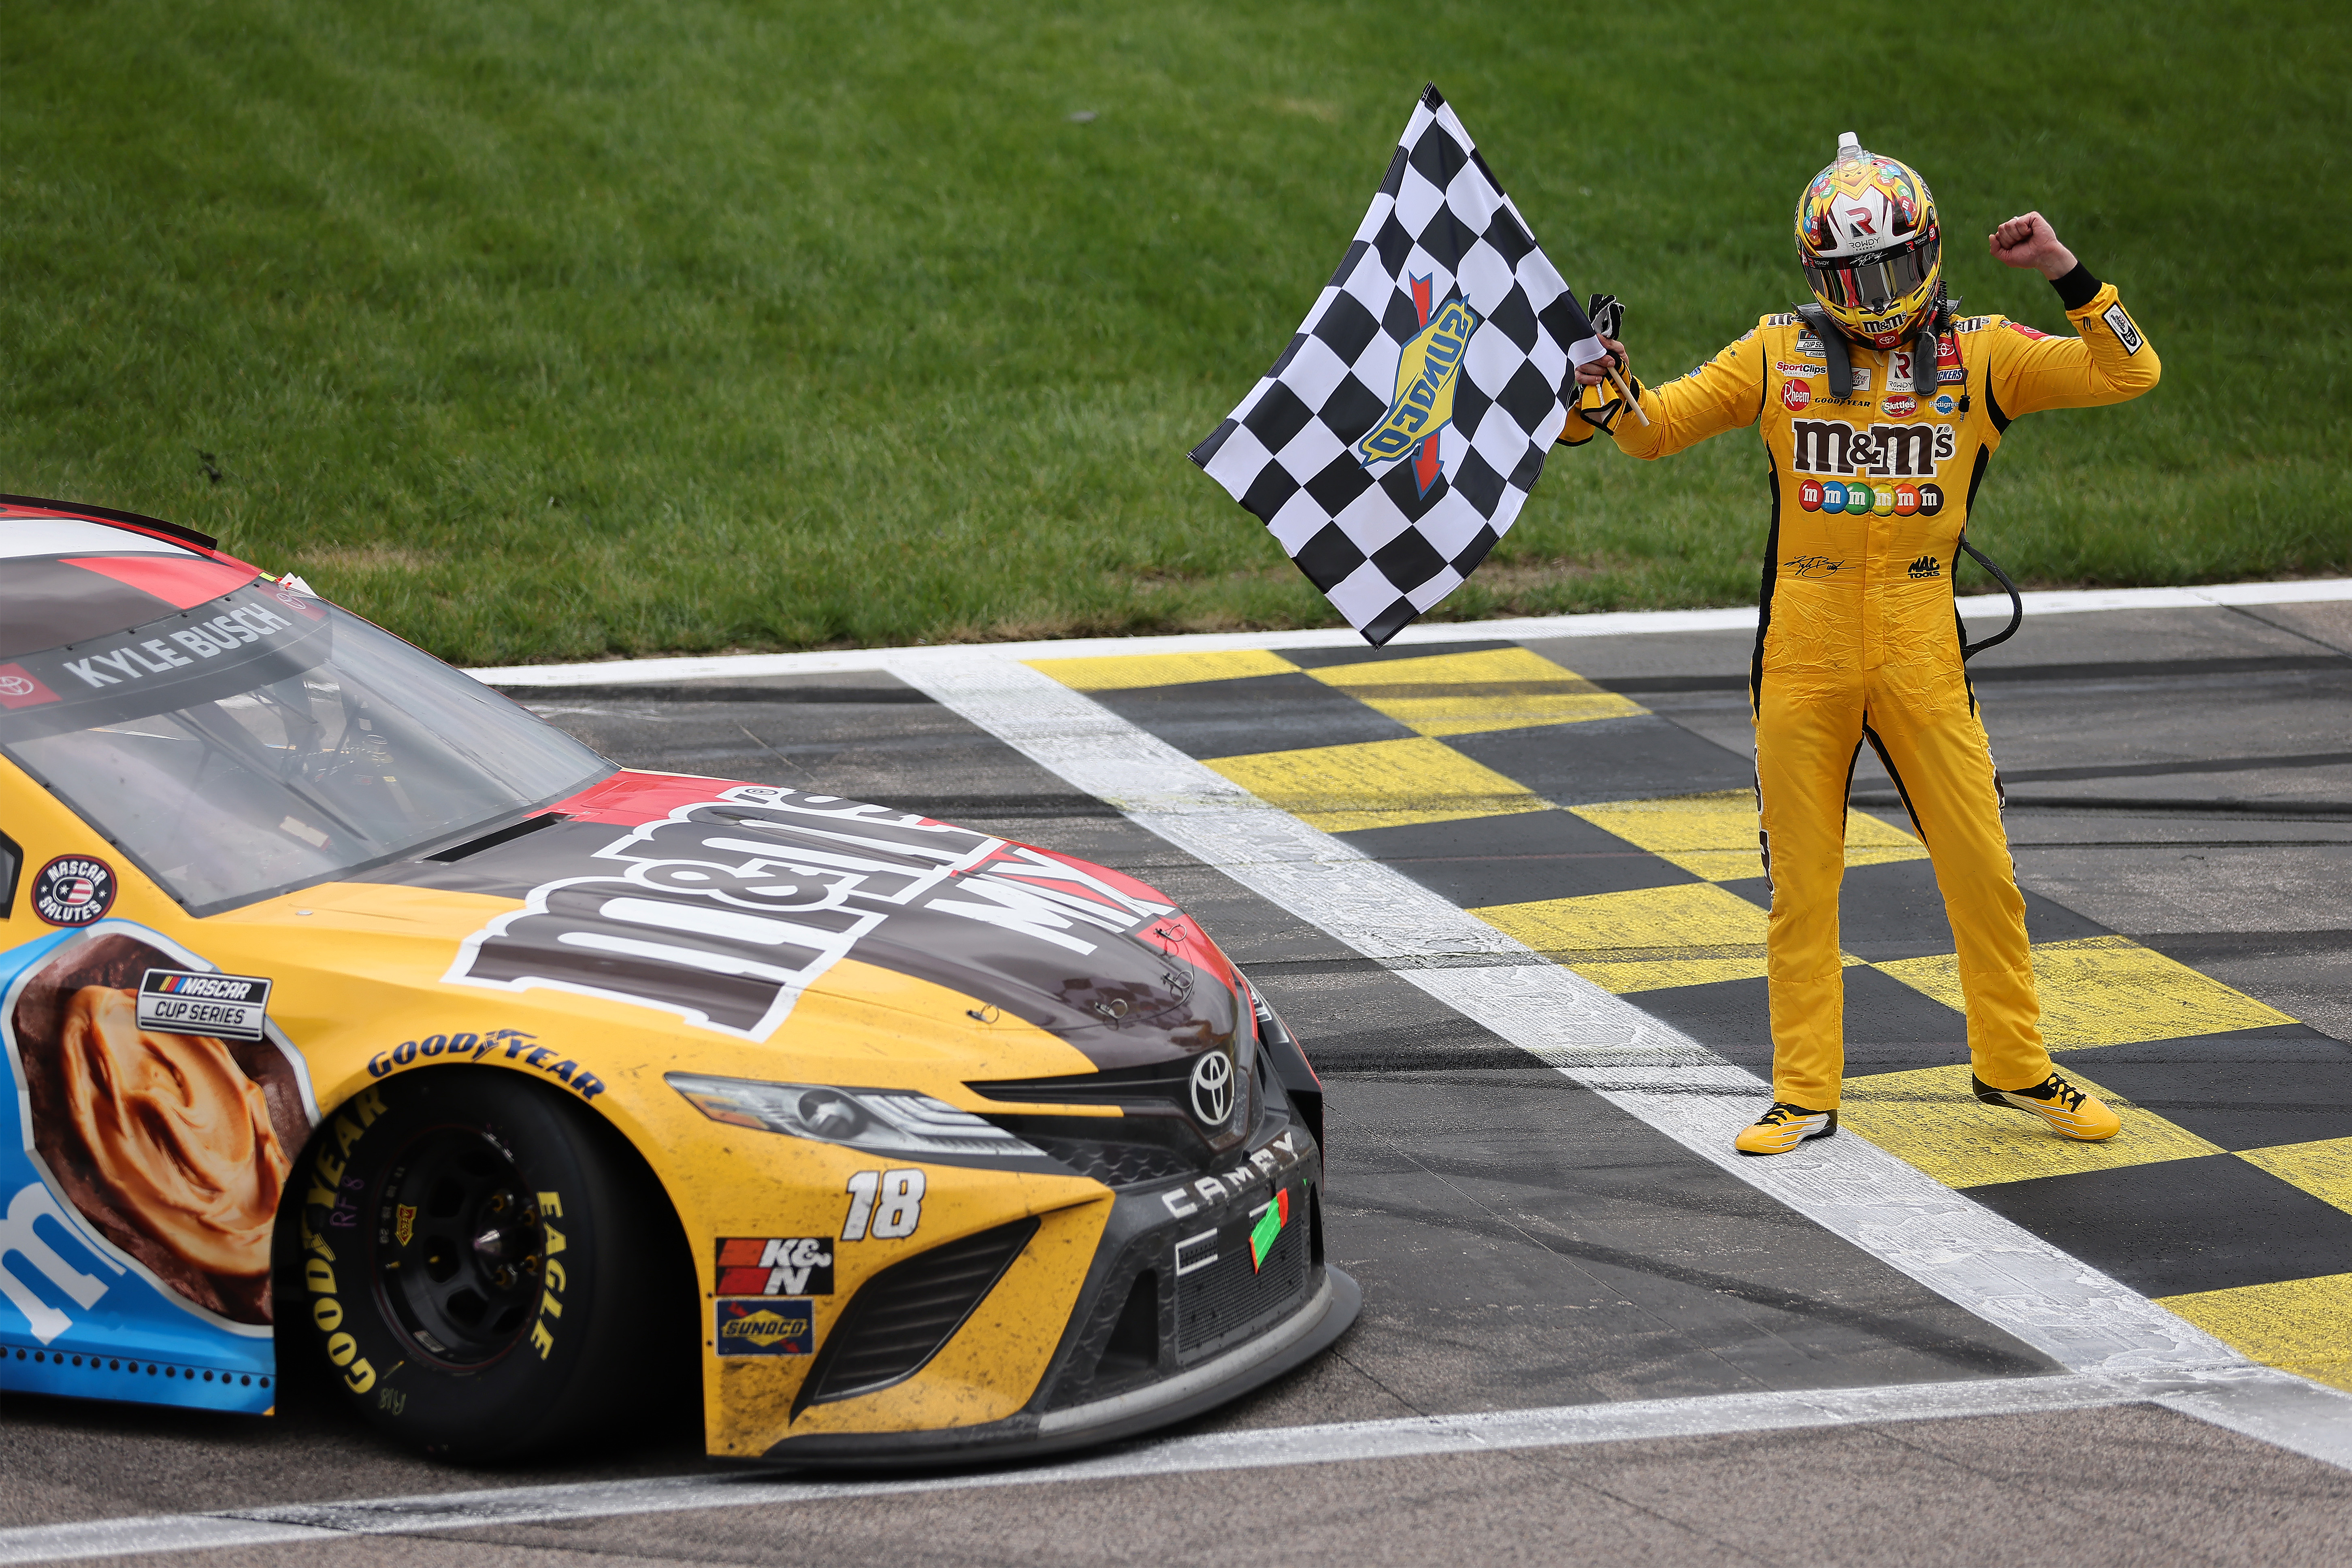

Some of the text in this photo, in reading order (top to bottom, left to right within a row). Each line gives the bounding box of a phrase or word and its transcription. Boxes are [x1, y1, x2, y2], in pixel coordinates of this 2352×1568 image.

[1849, 237, 1881, 248] ROWDY
[1914, 234, 1928, 245] ROWDY
[2125, 331, 2135, 344] sfi
[1776, 361, 1827, 374] SportClips
[1784, 379, 1810, 407] Rheem
[1815, 397, 1871, 407] GOODYEAR
[1883, 401, 1916, 411] Skittles
[1803, 488, 1937, 507] m m m m m m
[1907, 556, 1940, 573] MAC
[1908, 570, 1941, 579] TOOLS
[62, 603, 293, 688] KYLE BUSCH
[47, 859, 109, 887] NASCAR
[38, 895, 102, 922] SALUTES
[180, 977, 252, 1000] NASCAR
[155, 1001, 247, 1025] CUP SERIES
[368, 1029, 606, 1101] GOODYEAR
[1161, 1131, 1298, 1218] CAMRY
[841, 1168, 927, 1242] 18
[305, 1084, 388, 1394] GOODYEAR
[530, 1191, 567, 1361] EAGLE
[725, 1319, 807, 1336] SUNOCO
